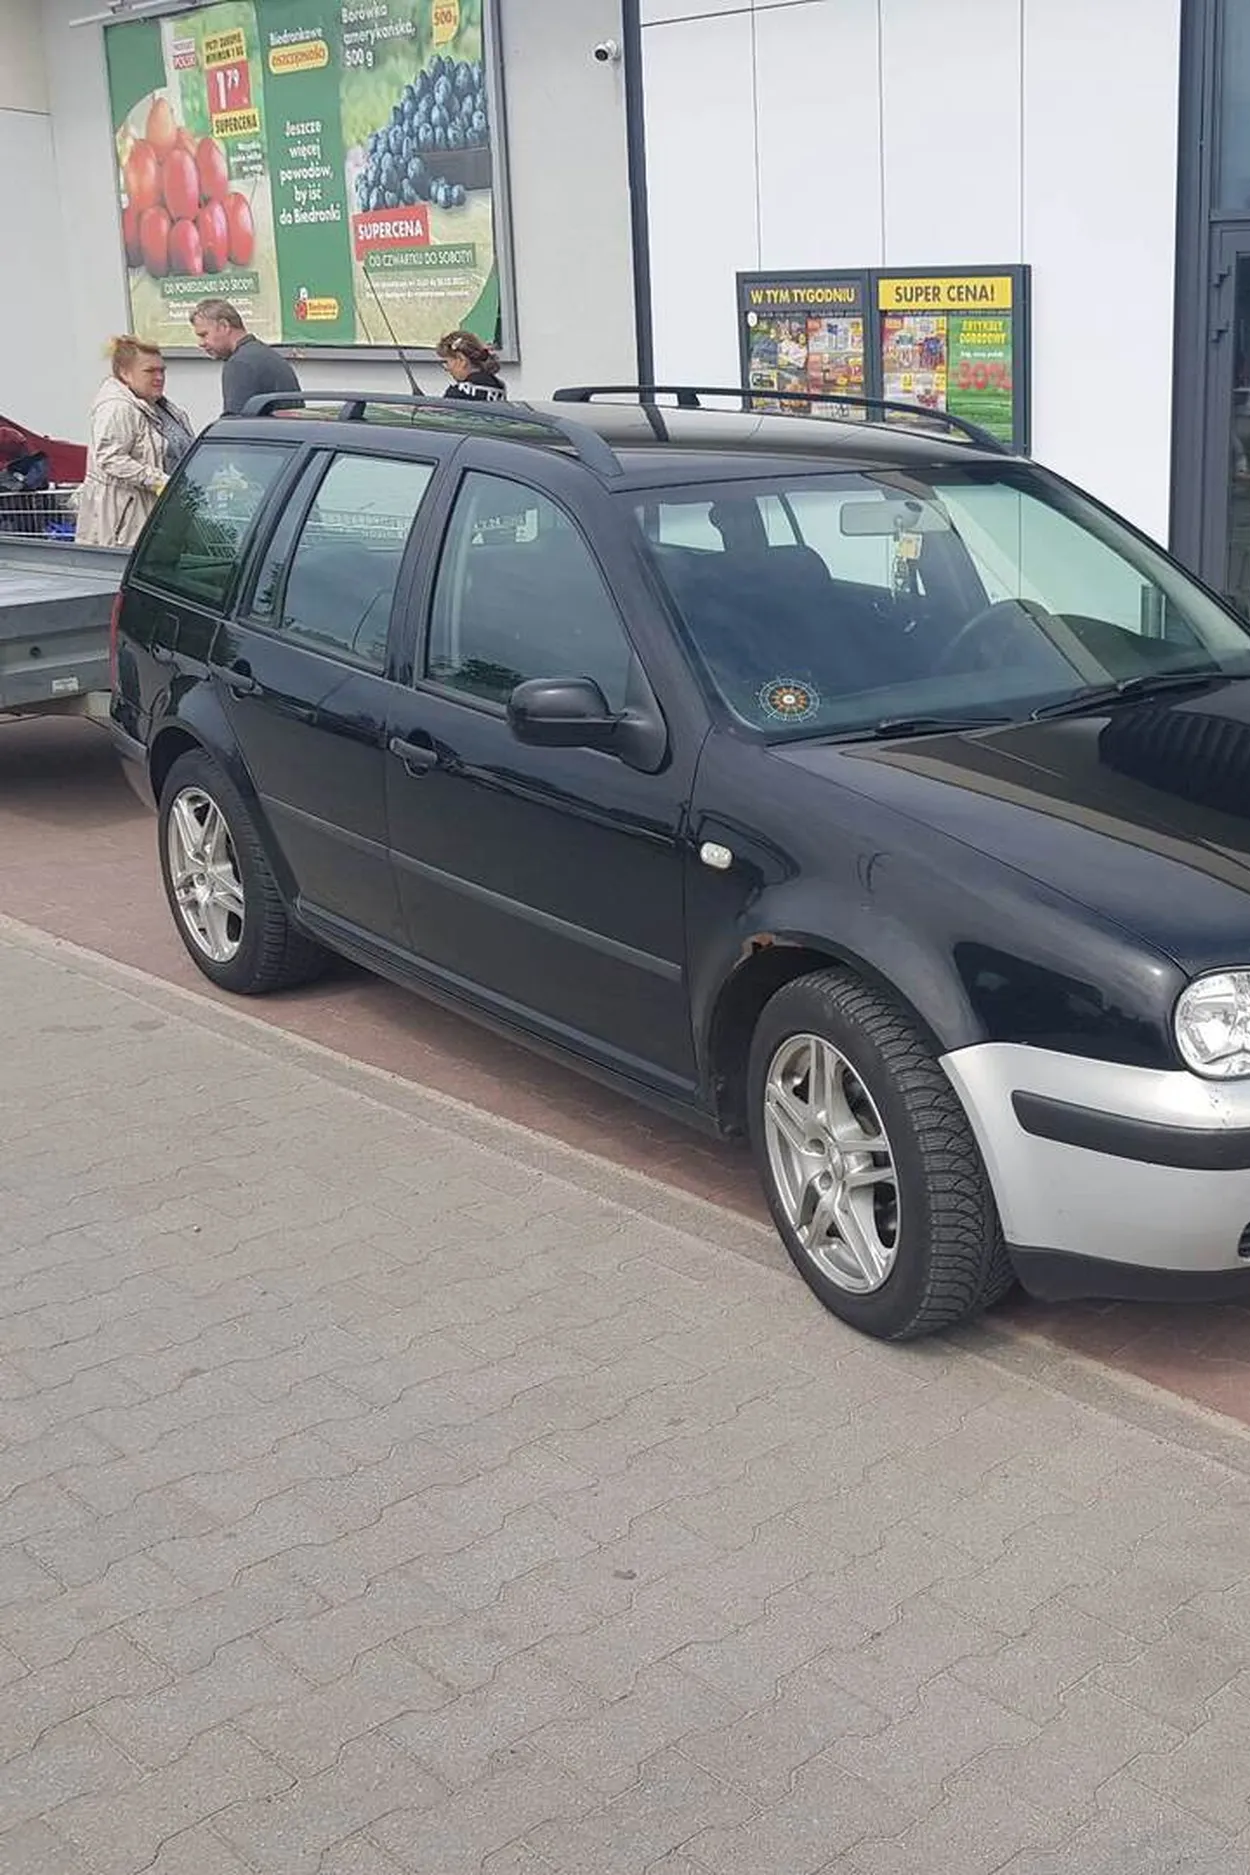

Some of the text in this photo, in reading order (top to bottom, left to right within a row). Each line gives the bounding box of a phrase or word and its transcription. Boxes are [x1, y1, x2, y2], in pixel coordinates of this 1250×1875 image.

[345, 47, 364, 67] 500
[284, 120, 322, 137] Jeszcze
[294, 184, 307, 206] by
[279, 207, 293, 225] do
[357, 220, 424, 240] SUPERCENA
[750, 286, 855, 304] W TYM TYGODNIU
[895, 284, 995, 303] SUPER CENA!
